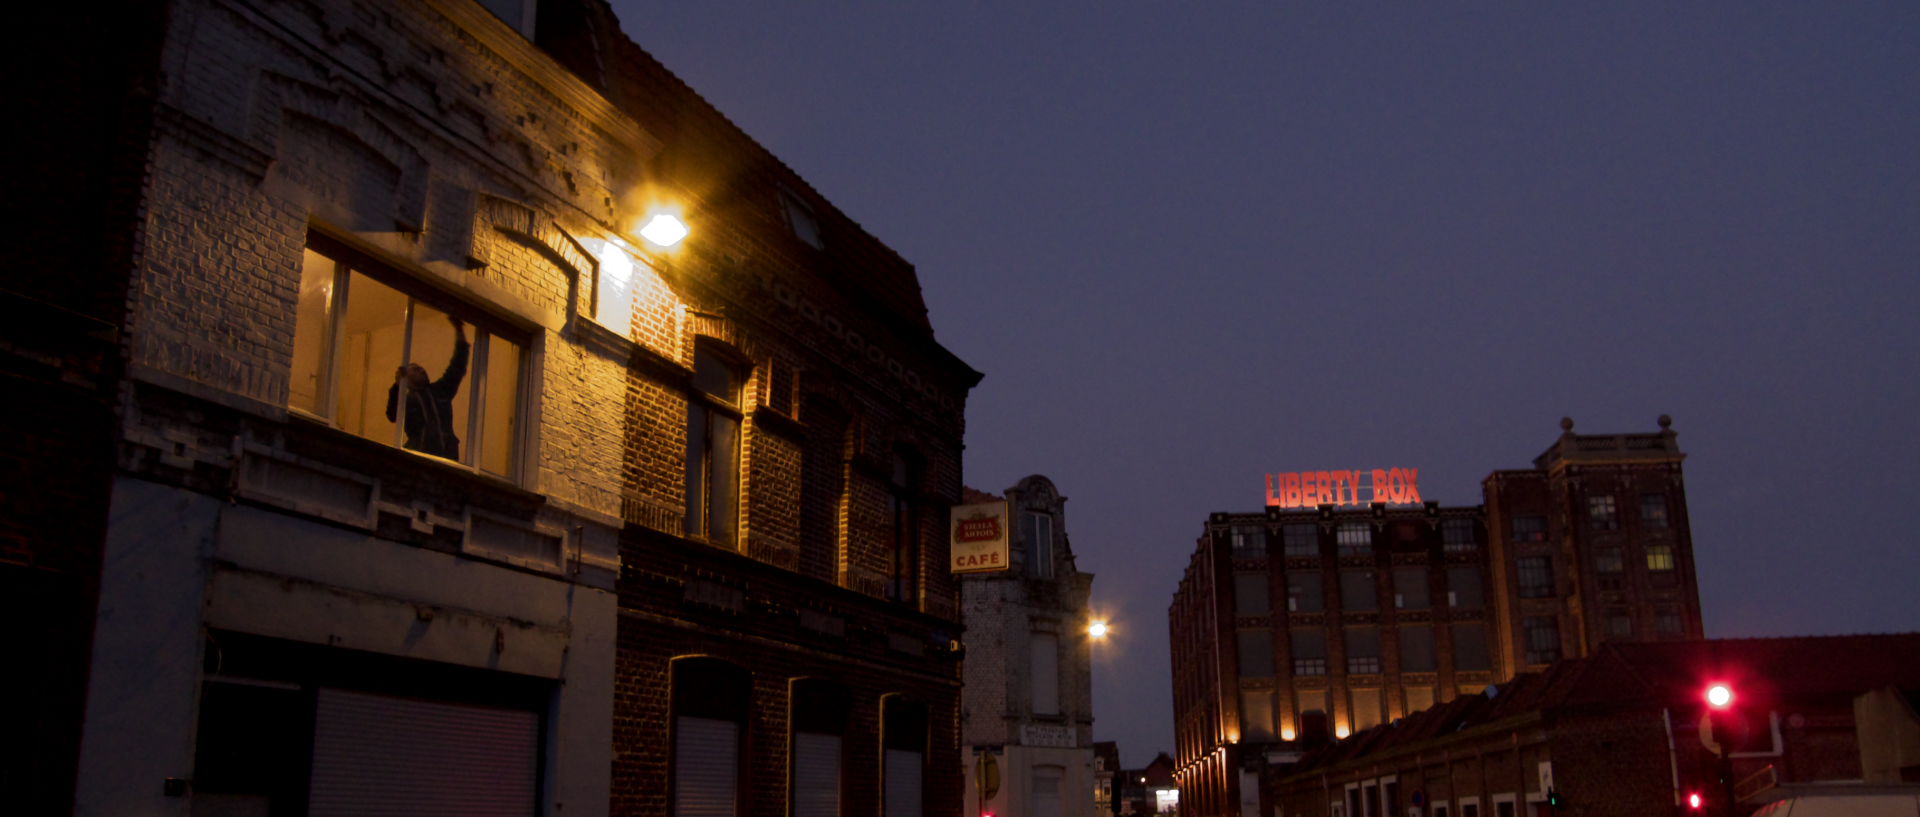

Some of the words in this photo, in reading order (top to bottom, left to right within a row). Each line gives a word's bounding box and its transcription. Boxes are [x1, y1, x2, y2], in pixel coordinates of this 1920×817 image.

[1265, 469, 1361, 508] LIBERTY
[1372, 467, 1421, 505] BOX
[956, 552, 999, 567] CAFÉ
